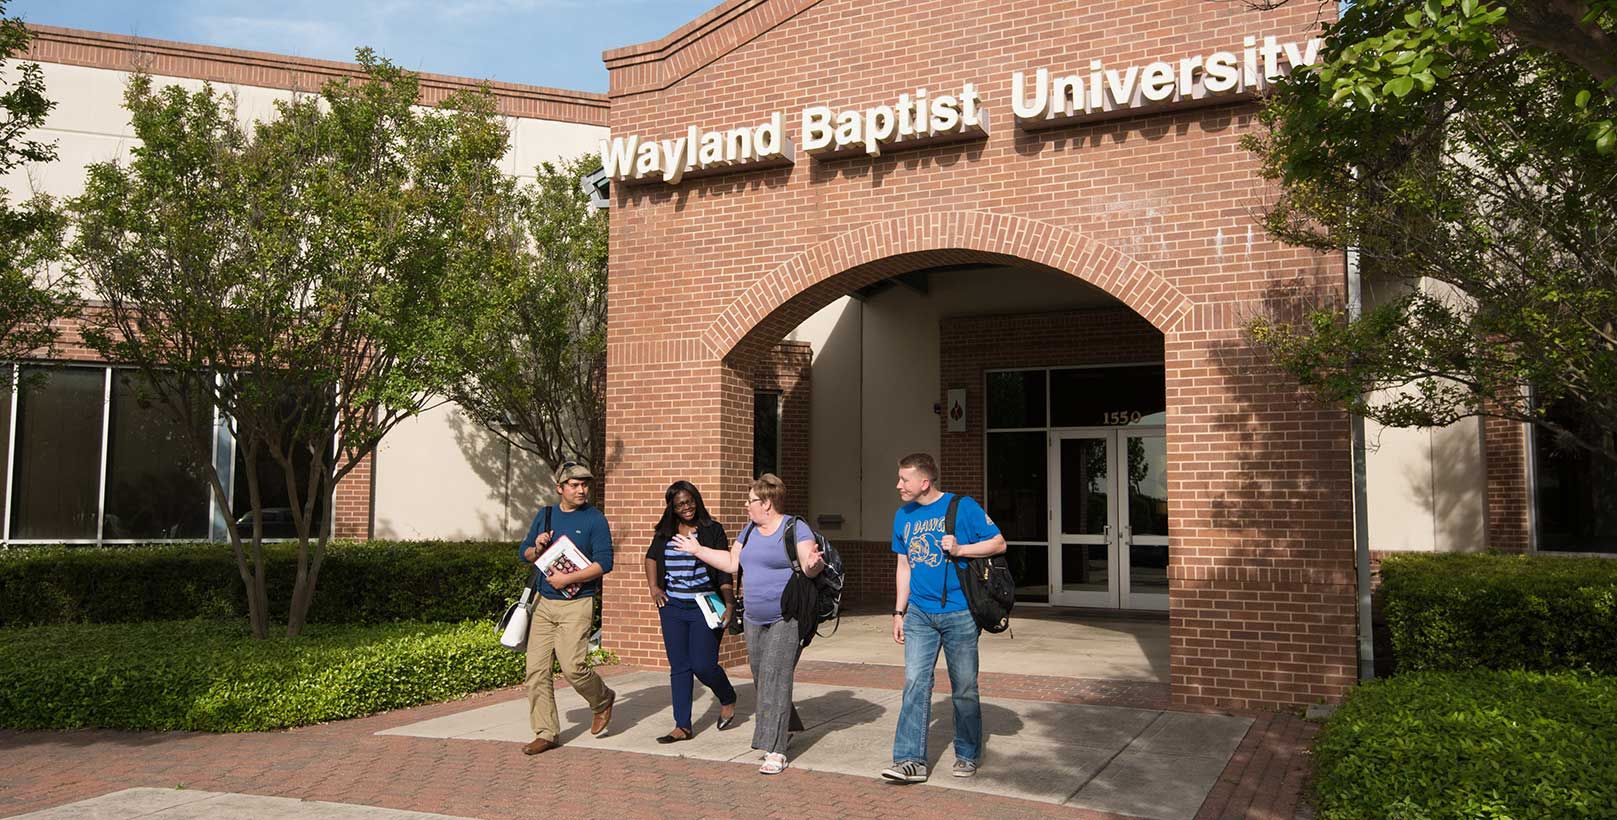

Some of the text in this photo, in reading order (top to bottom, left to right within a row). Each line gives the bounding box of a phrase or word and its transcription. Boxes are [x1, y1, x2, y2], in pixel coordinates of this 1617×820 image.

[600, 110, 786, 185] Wayland
[802, 82, 980, 157] Baptist
[1103, 410, 1142, 425] 1550
